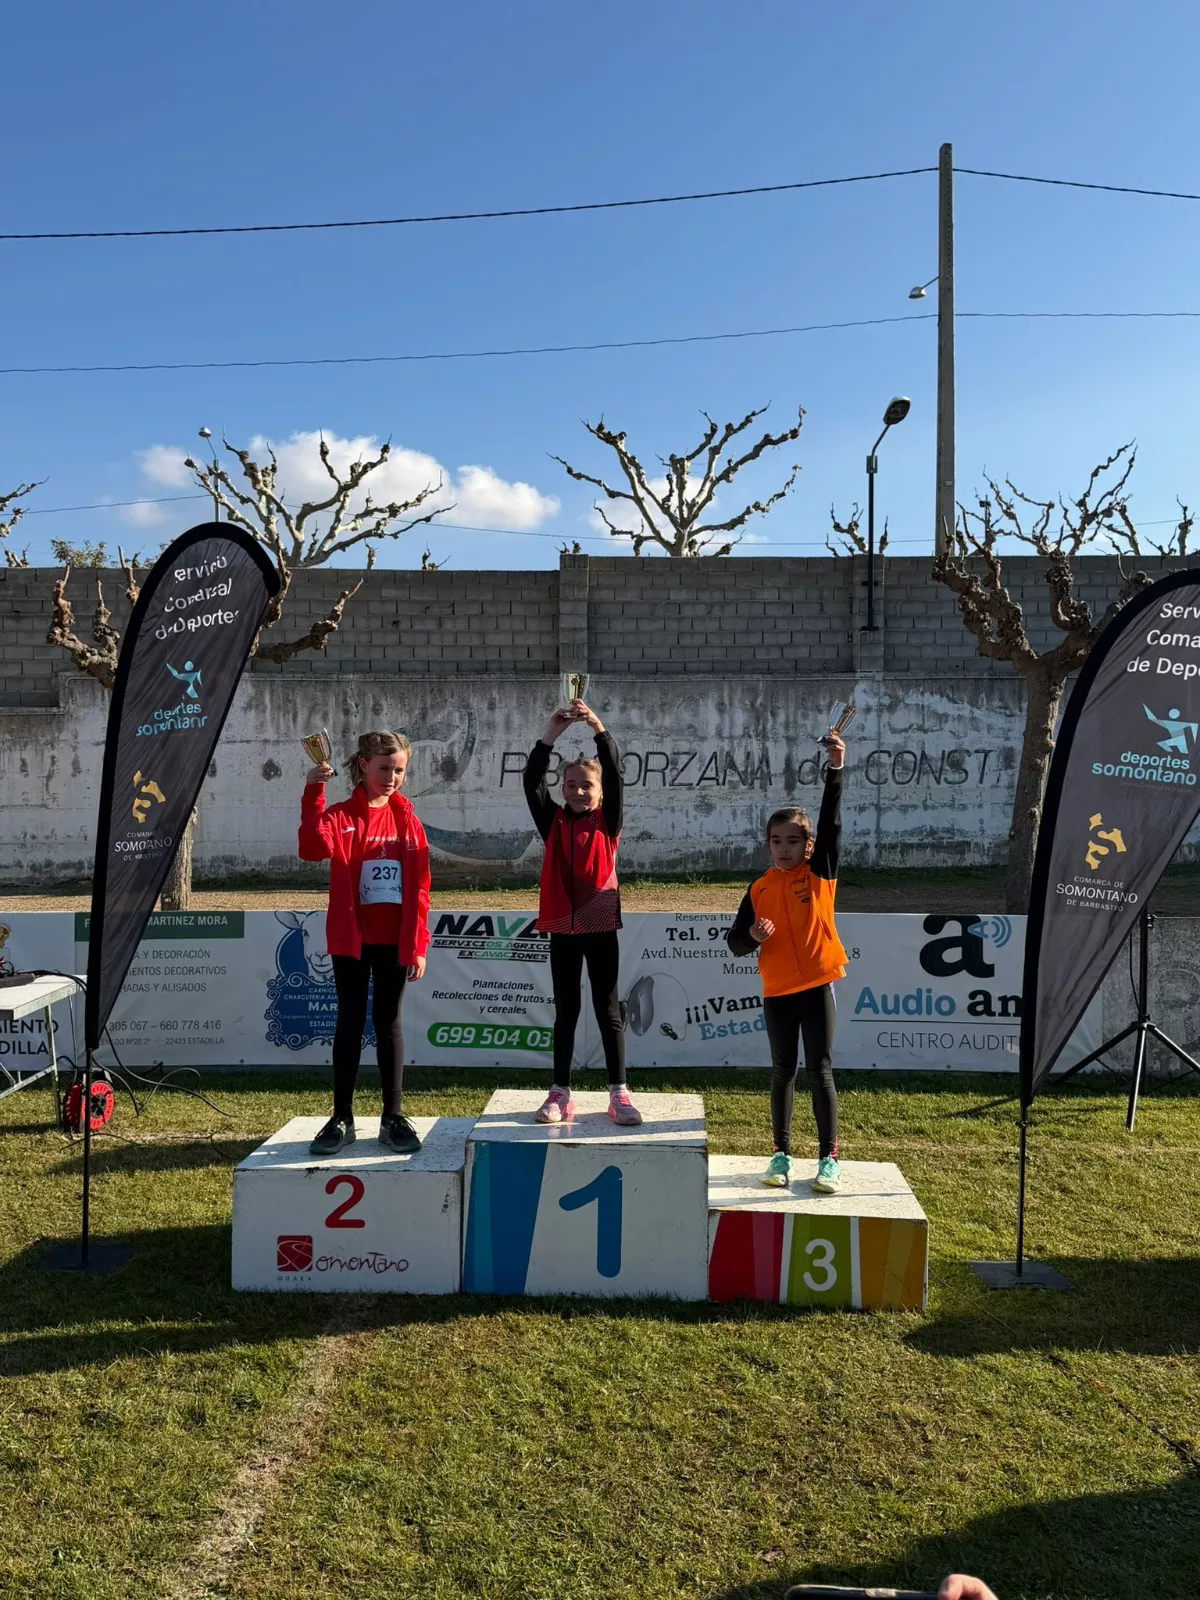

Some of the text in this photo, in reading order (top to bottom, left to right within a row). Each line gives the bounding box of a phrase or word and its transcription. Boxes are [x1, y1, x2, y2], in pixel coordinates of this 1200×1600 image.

[1126, 656, 1200, 681] de Dep
[1120, 751, 1190, 770] deportes
[1092, 762, 1197, 786] somontano
[371, 866, 399, 881] 237
[1073, 875, 1125, 889] COMARCA DE
[1056, 883, 1139, 904] SOMONTANO
[1066, 898, 1077, 907] DE
[197, 915, 228, 926] MORA
[675, 912, 717, 922] Reserva
[665, 927, 700, 941] Tel.
[432, 939, 502, 948] SERVICIOS
[143, 950, 149, 959] Y
[152, 948, 211, 959] DECORACIÓN
[458, 950, 549, 960] EXCAVACIONES
[126, 966, 227, 976] IENTOS DECORATIVOS
[153, 982, 159, 991] Y
[162, 982, 207, 992] ALISADOS
[472, 979, 534, 991] Plantaciones
[431, 990, 499, 1002] Recolecciones
[501, 993, 514, 1002] de
[515, 993, 545, 1004] frutos
[854, 986, 956, 1017] Audio
[479, 1004, 527, 1015] y cereales
[0, 1019, 59, 1034] IENTO
[108, 1021, 128, 1031] 305
[130, 1020, 148, 1031] 067
[160, 1020, 178, 1030] 660
[181, 1020, 200, 1030] 778
[202, 1019, 221, 1030] 416
[698, 1013, 766, 1041] Estad
[187, 1037, 225, 1045] ESTADILLA
[435, 1026, 553, 1048] 699 504 03
[876, 1031, 1017, 1051] CENTRO AUDIT
[325, 1174, 365, 1229] 2
[558, 1165, 624, 1279] 1
[802, 1238, 838, 1291] 3
